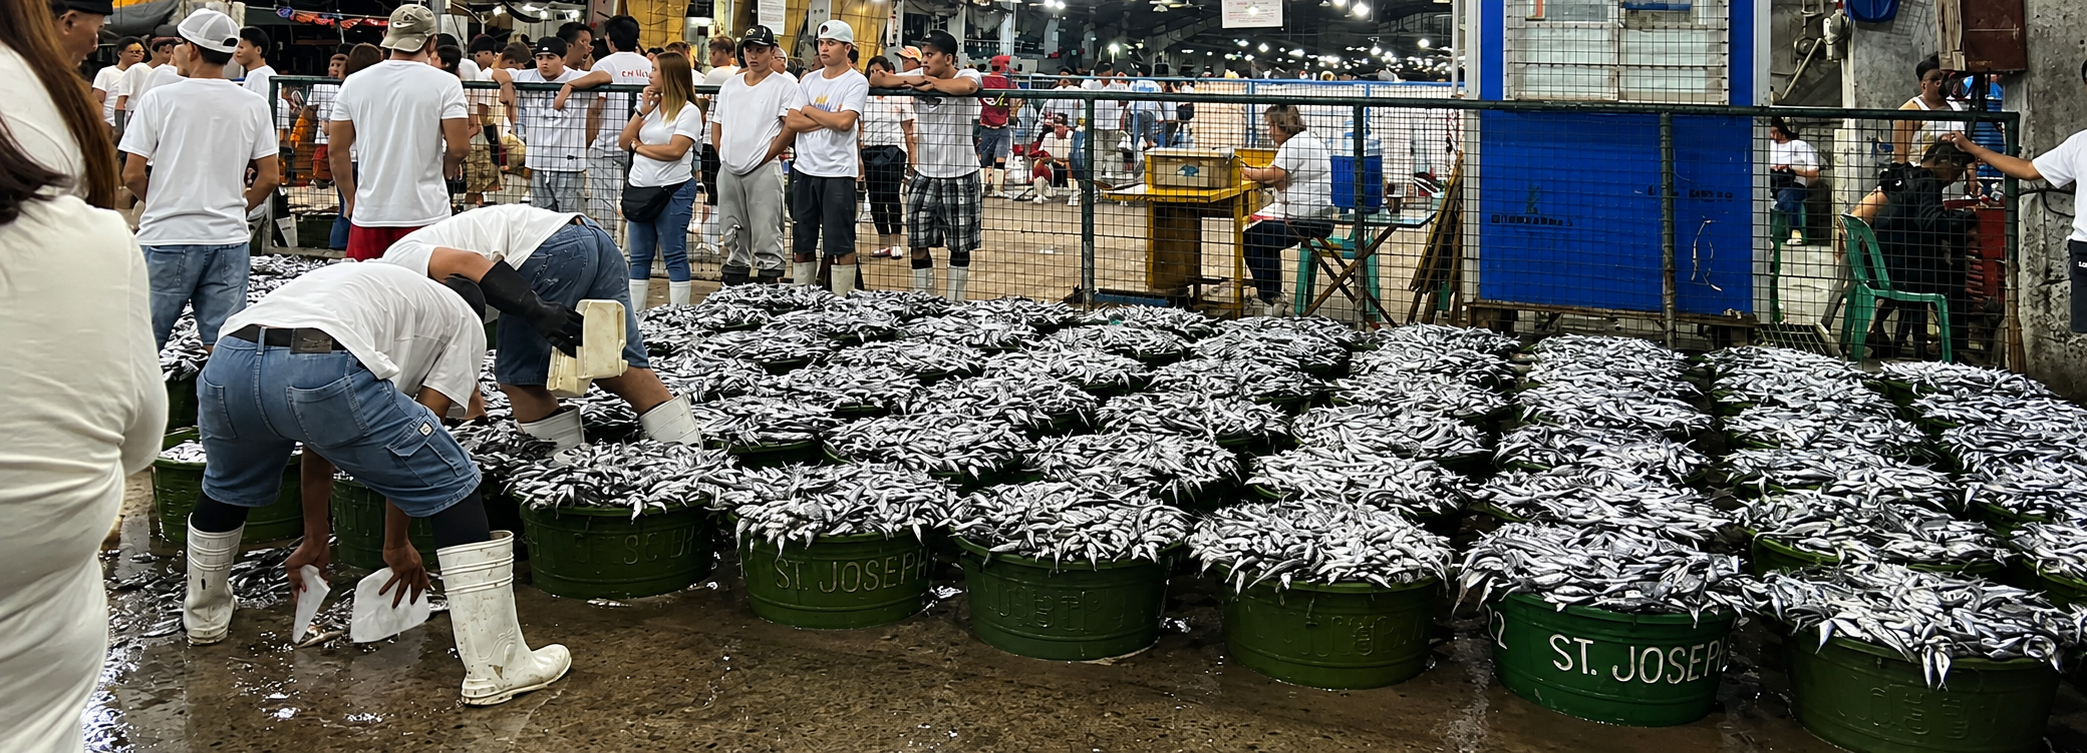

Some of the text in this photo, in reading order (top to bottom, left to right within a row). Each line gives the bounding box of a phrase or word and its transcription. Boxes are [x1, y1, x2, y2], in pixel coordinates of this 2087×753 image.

[773, 547, 931, 594] ST. JOSEPH
[1548, 633, 1599, 677] ST.
